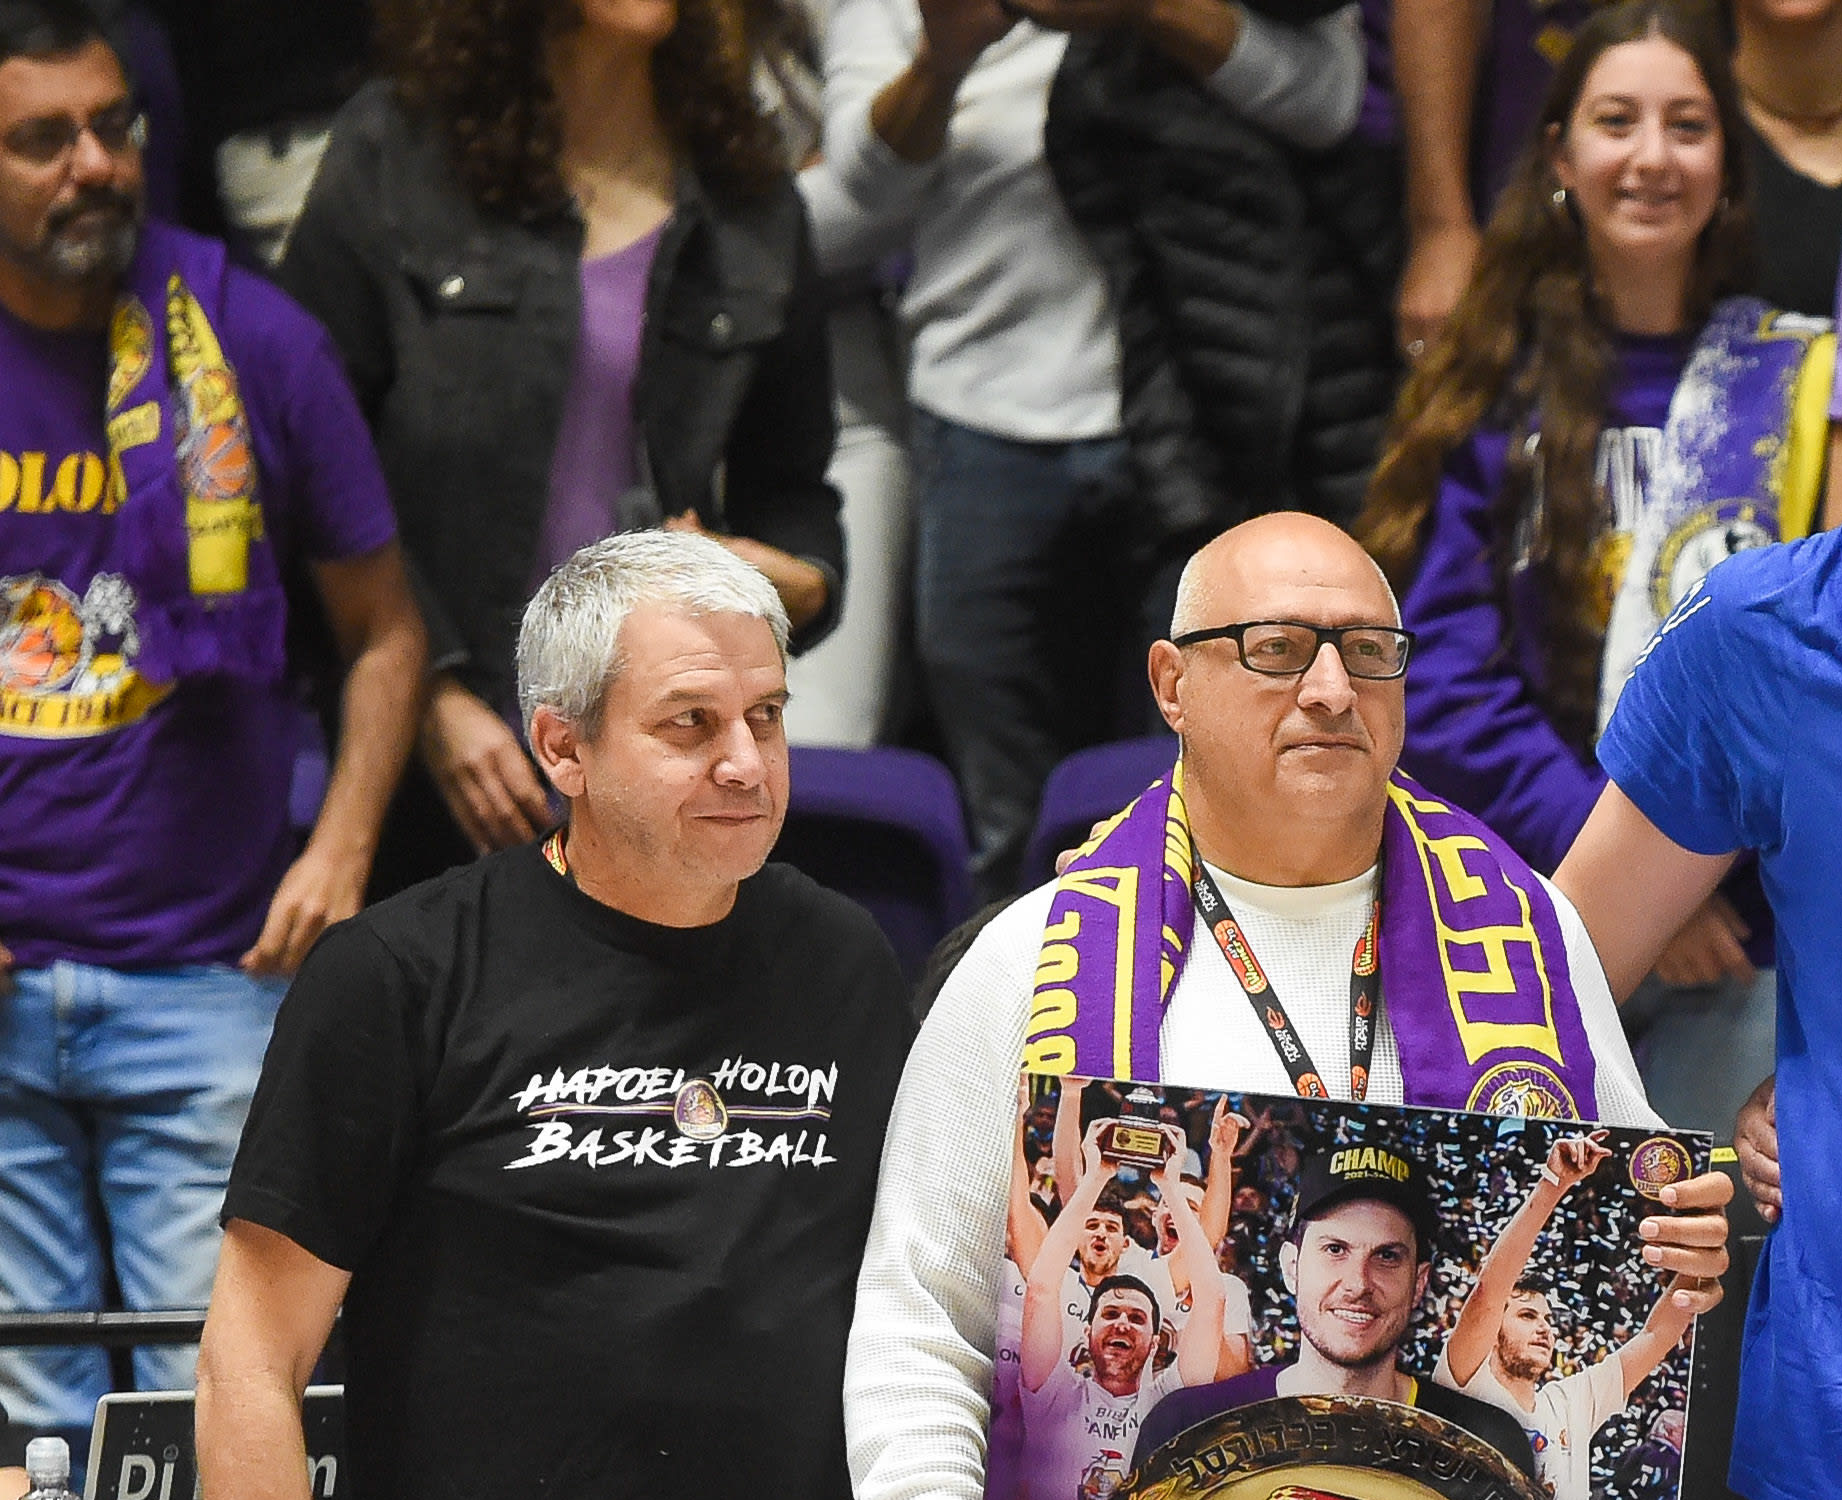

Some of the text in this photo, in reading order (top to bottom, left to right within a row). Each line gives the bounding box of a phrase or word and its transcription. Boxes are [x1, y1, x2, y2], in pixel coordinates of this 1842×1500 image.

[509, 1054, 840, 1113] HAPOEL HOLON
[502, 1114, 838, 1171] BASKETBALL
[1329, 1146, 1410, 1182] CHAMP
